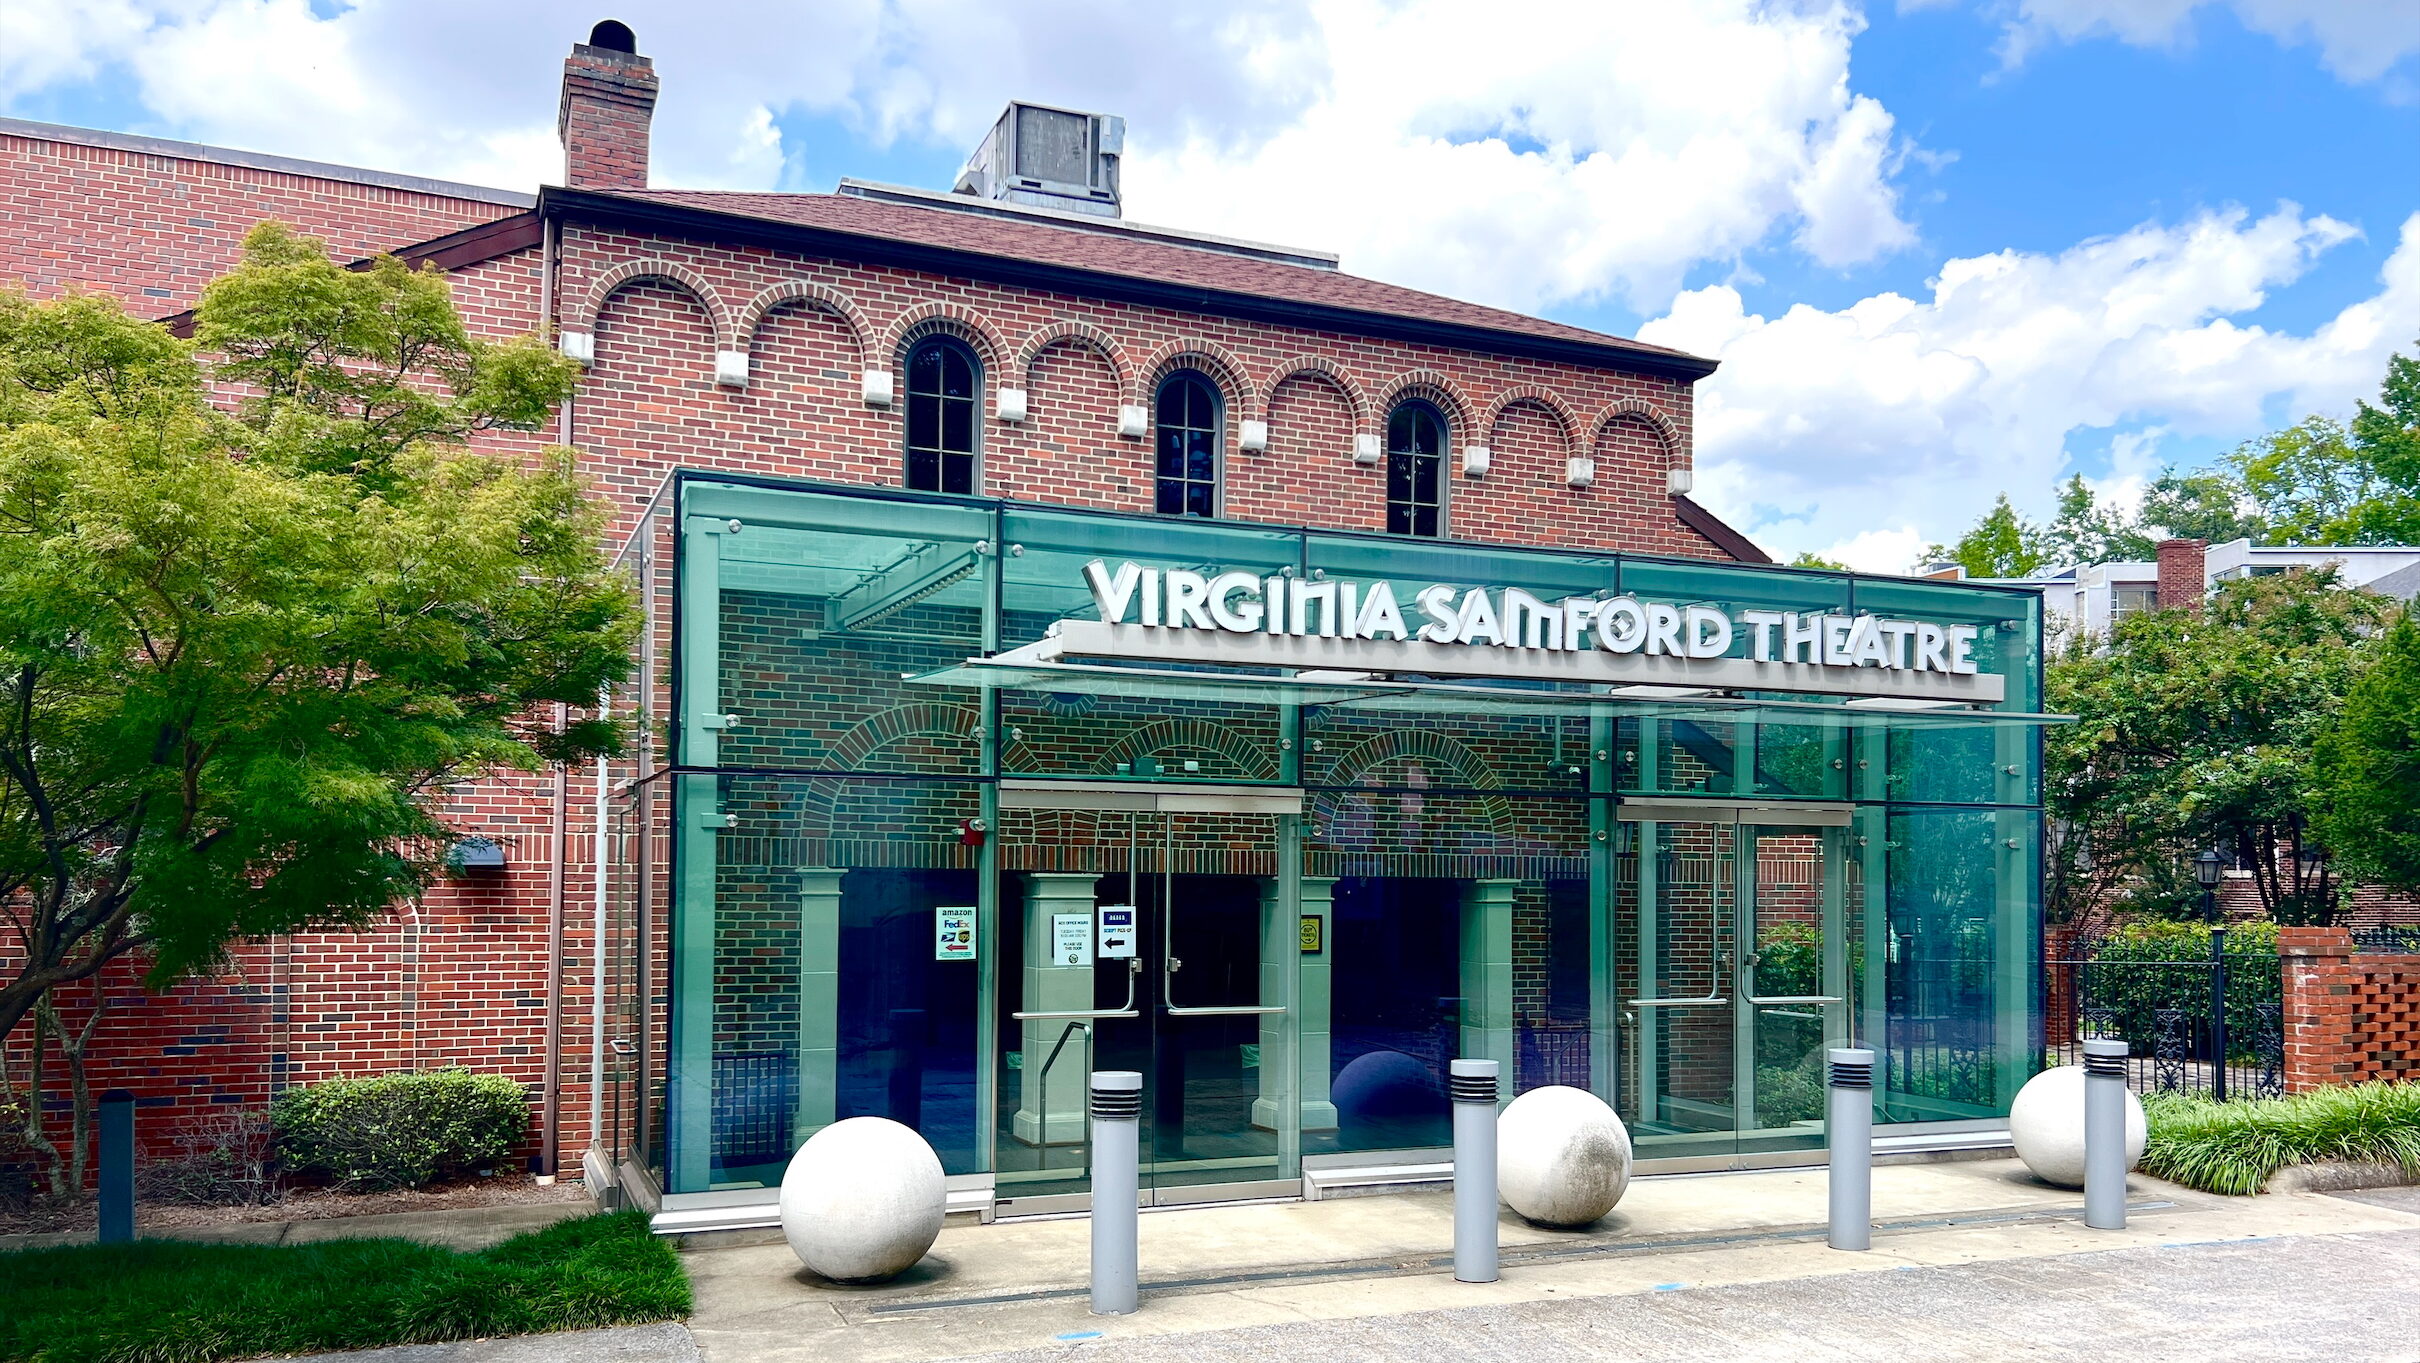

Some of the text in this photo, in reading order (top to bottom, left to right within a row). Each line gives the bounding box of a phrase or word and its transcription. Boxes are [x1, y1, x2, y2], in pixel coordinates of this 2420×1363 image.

[1081, 558, 1978, 675] VIRGINIA SAMFORD THEATRE
[944, 919, 970, 928] FedEx
